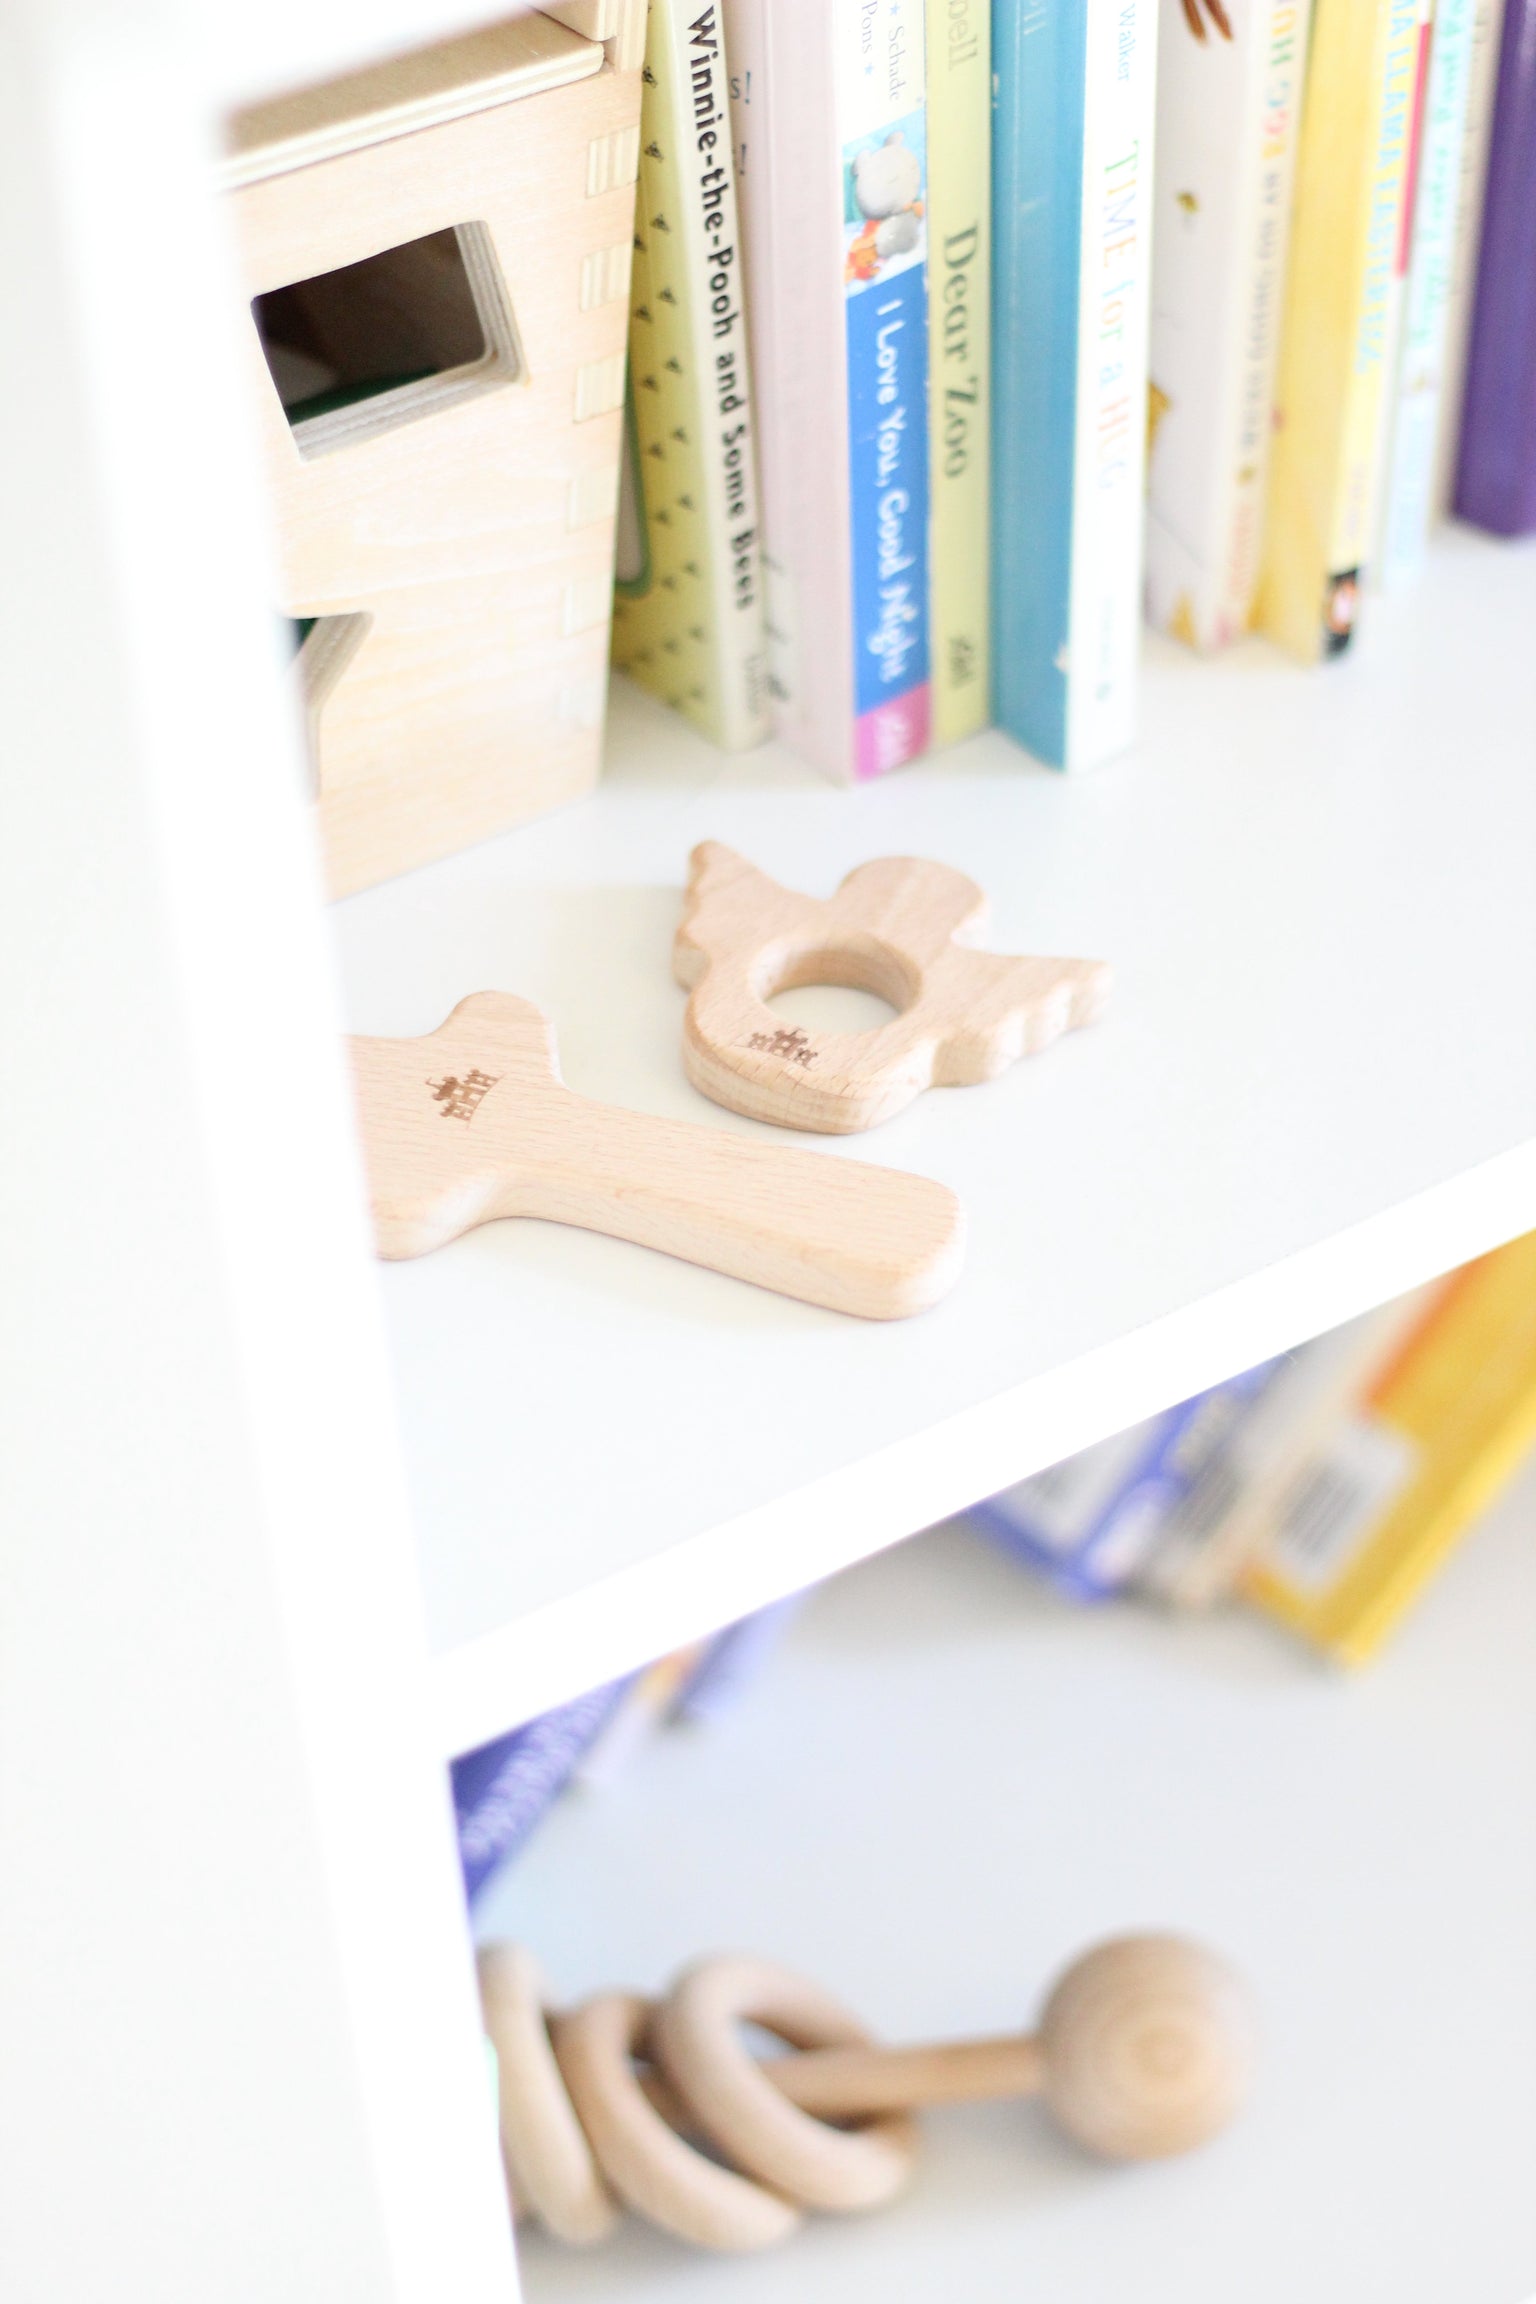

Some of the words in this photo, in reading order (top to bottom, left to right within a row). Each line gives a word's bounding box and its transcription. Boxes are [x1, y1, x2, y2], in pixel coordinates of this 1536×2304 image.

[860, 0, 878, 55] Pons
[887, 24, 907, 101] Schade
[1116, 3, 1136, 82] Walker
[1376, 46, 1412, 171] LLAMA
[688, 5, 739, 339] Winnie-the-Pooh
[1102, 138, 1139, 269] TIME
[876, 299, 904, 316] I
[943, 218, 979, 363] Dear
[1100, 277, 1136, 344] for
[714, 351, 746, 415] and
[876, 320, 905, 405] Love
[1099, 361, 1124, 387] a
[874, 407, 908, 488] You,
[943, 375, 980, 479] Zoo
[721, 423, 747, 520] Some
[730, 527, 757, 611] Bees
[876, 487, 917, 581] Good
[866, 583, 919, 684] Night
